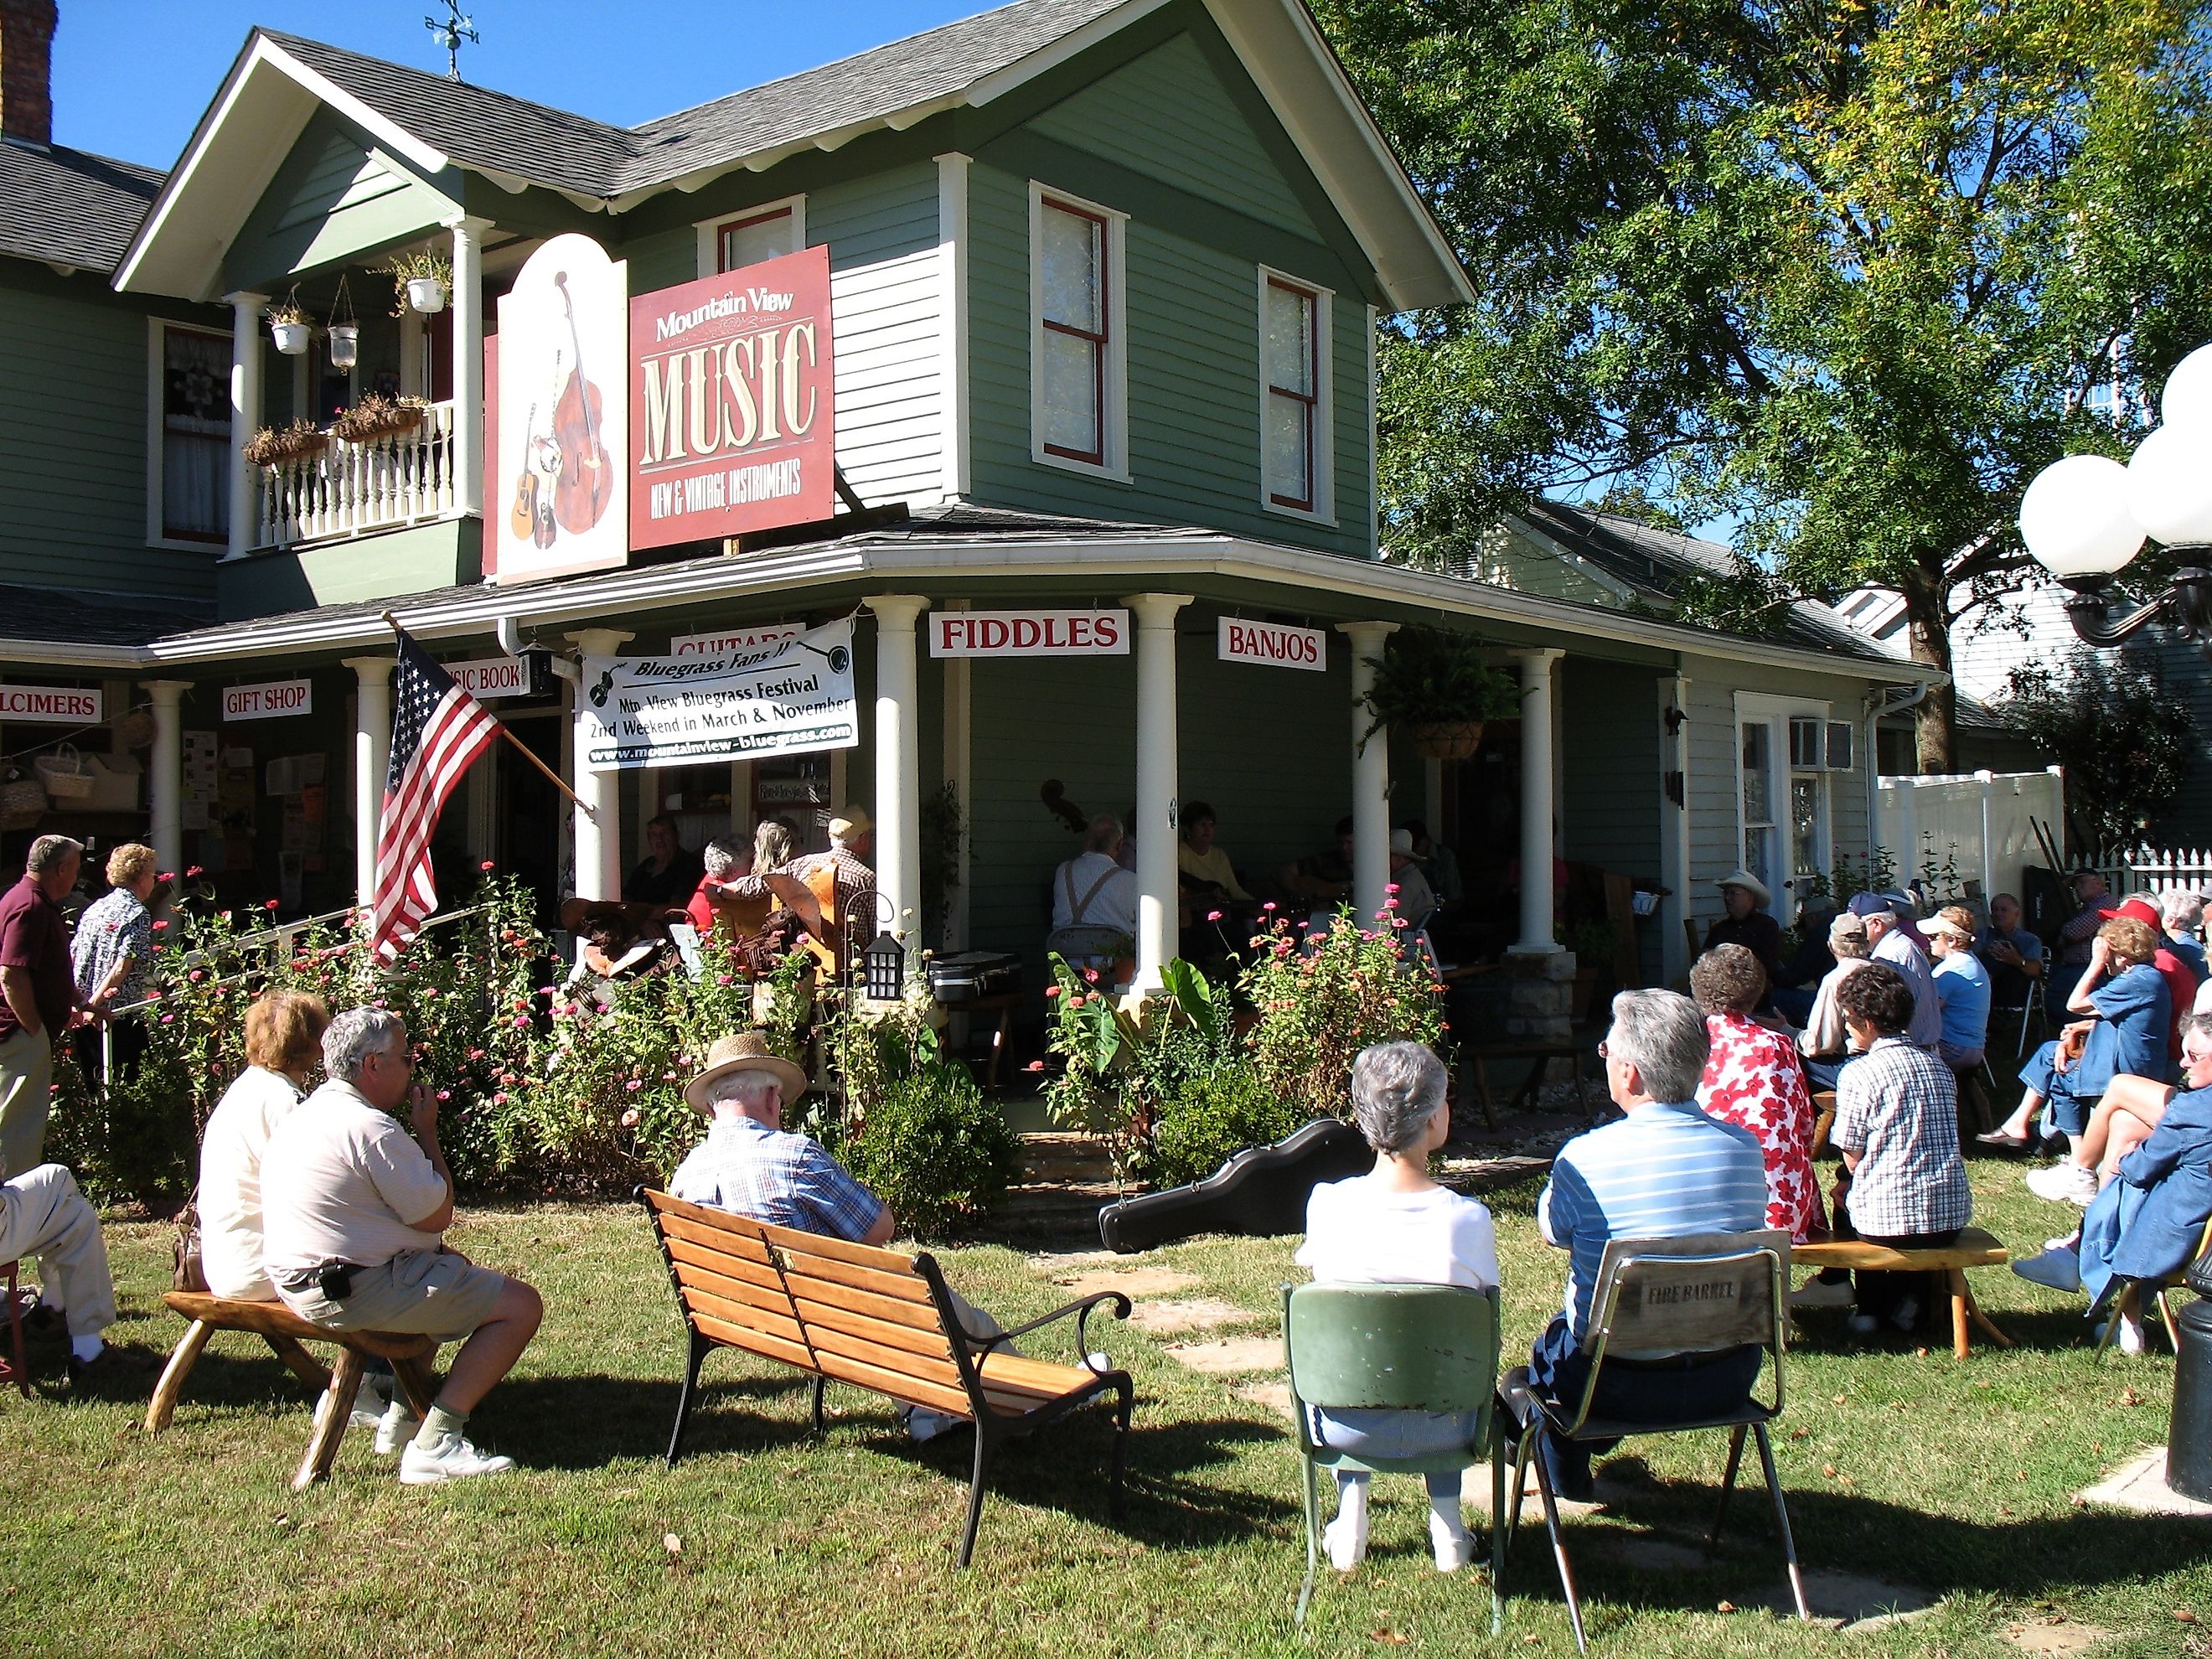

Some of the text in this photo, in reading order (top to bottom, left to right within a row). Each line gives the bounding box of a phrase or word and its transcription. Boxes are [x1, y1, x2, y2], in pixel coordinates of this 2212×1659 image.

[655, 287, 794, 344] Mountain View
[638, 322, 816, 466] MUSIC
[650, 457, 802, 519] NEW & VINTAGE INSTRUMENTS
[941, 617, 1119, 649] FIDDLES
[1228, 625, 1318, 664] BANJOS
[448, 668, 476, 690] SIC
[633, 659, 726, 680] Bluegrass
[728, 649, 771, 669] Fans
[226, 686, 307, 714] GIFT SHOP
[619, 674, 819, 714] Mtn. View Bluegrass Festival
[591, 696, 850, 737] 2nd Weekend in March & November
[590, 725, 852, 762] www.mountainview-bluegrass.com
